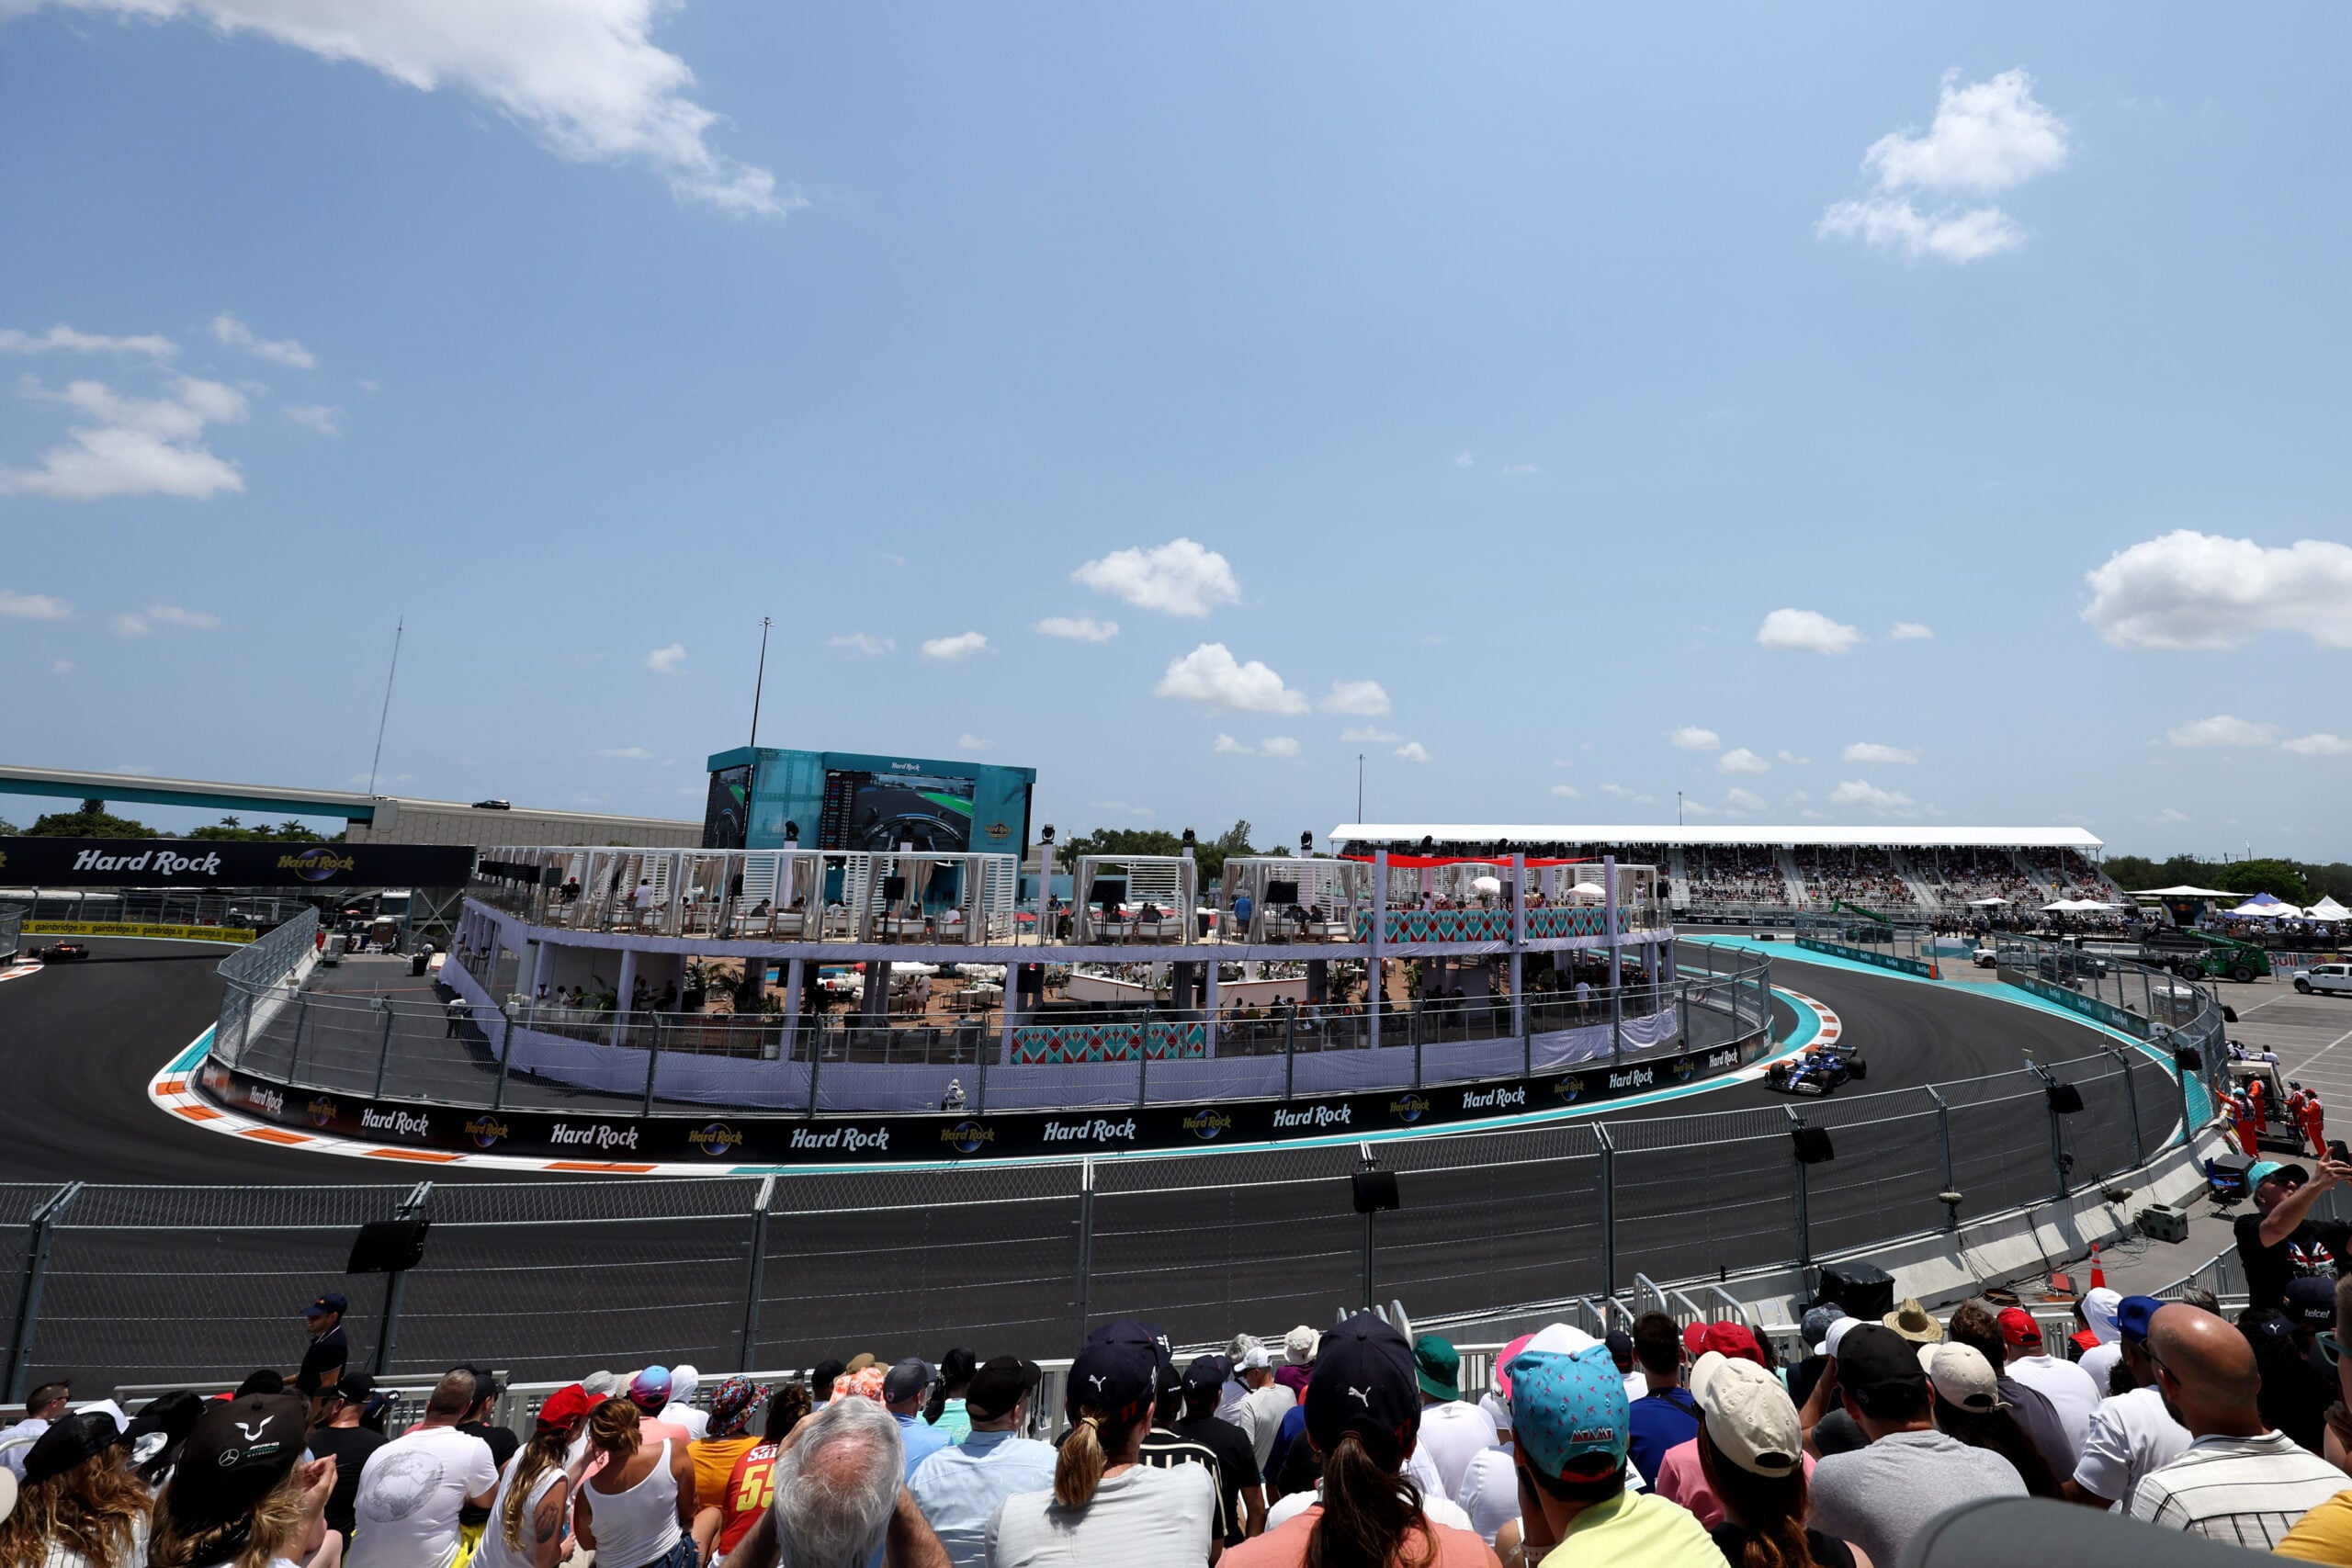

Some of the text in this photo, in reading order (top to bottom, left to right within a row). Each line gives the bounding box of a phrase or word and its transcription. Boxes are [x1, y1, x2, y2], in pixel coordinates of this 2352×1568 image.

[906, 762, 921, 772] Rock
[73, 850, 221, 875] Hard Rock
[277, 854, 355, 871] Hard Rock
[35, 923, 86, 932] gainbridge.io
[92, 924, 138, 934] gainbridge.io
[142, 928, 183, 936] gainbridge.io
[2267, 953, 2300, 967] Bull
[1709, 1051, 1724, 1068] Hard
[1724, 1047, 1738, 1066] Rock
[1609, 1066, 1653, 1089] Hard Rock
[1554, 1080, 1585, 1093] Hard Rock
[249, 1085, 268, 1105] Hard
[266, 1089, 283, 1114] Rock
[1389, 1099, 1430, 1112] Hard Rock
[1463, 1086, 1525, 1109] Hard Rock
[361, 1108, 429, 1137] Hard Rock
[1182, 1114, 1231, 1129] Hard Rock
[1272, 1103, 1351, 1127] Hard Rock
[464, 1121, 509, 1138] Hard Rock
[550, 1123, 639, 1149] Hard Rock
[688, 1130, 742, 1145] Hard Rock
[940, 1127, 995, 1142] Hard Rock
[1043, 1118, 1136, 1142] Hard Rock
[789, 1127, 889, 1151] Hard Rock
[2304, 1308, 2330, 1319] telcel
[1569, 1427, 1612, 1444] MIAMI
[747, 1443, 779, 1462] Sai
